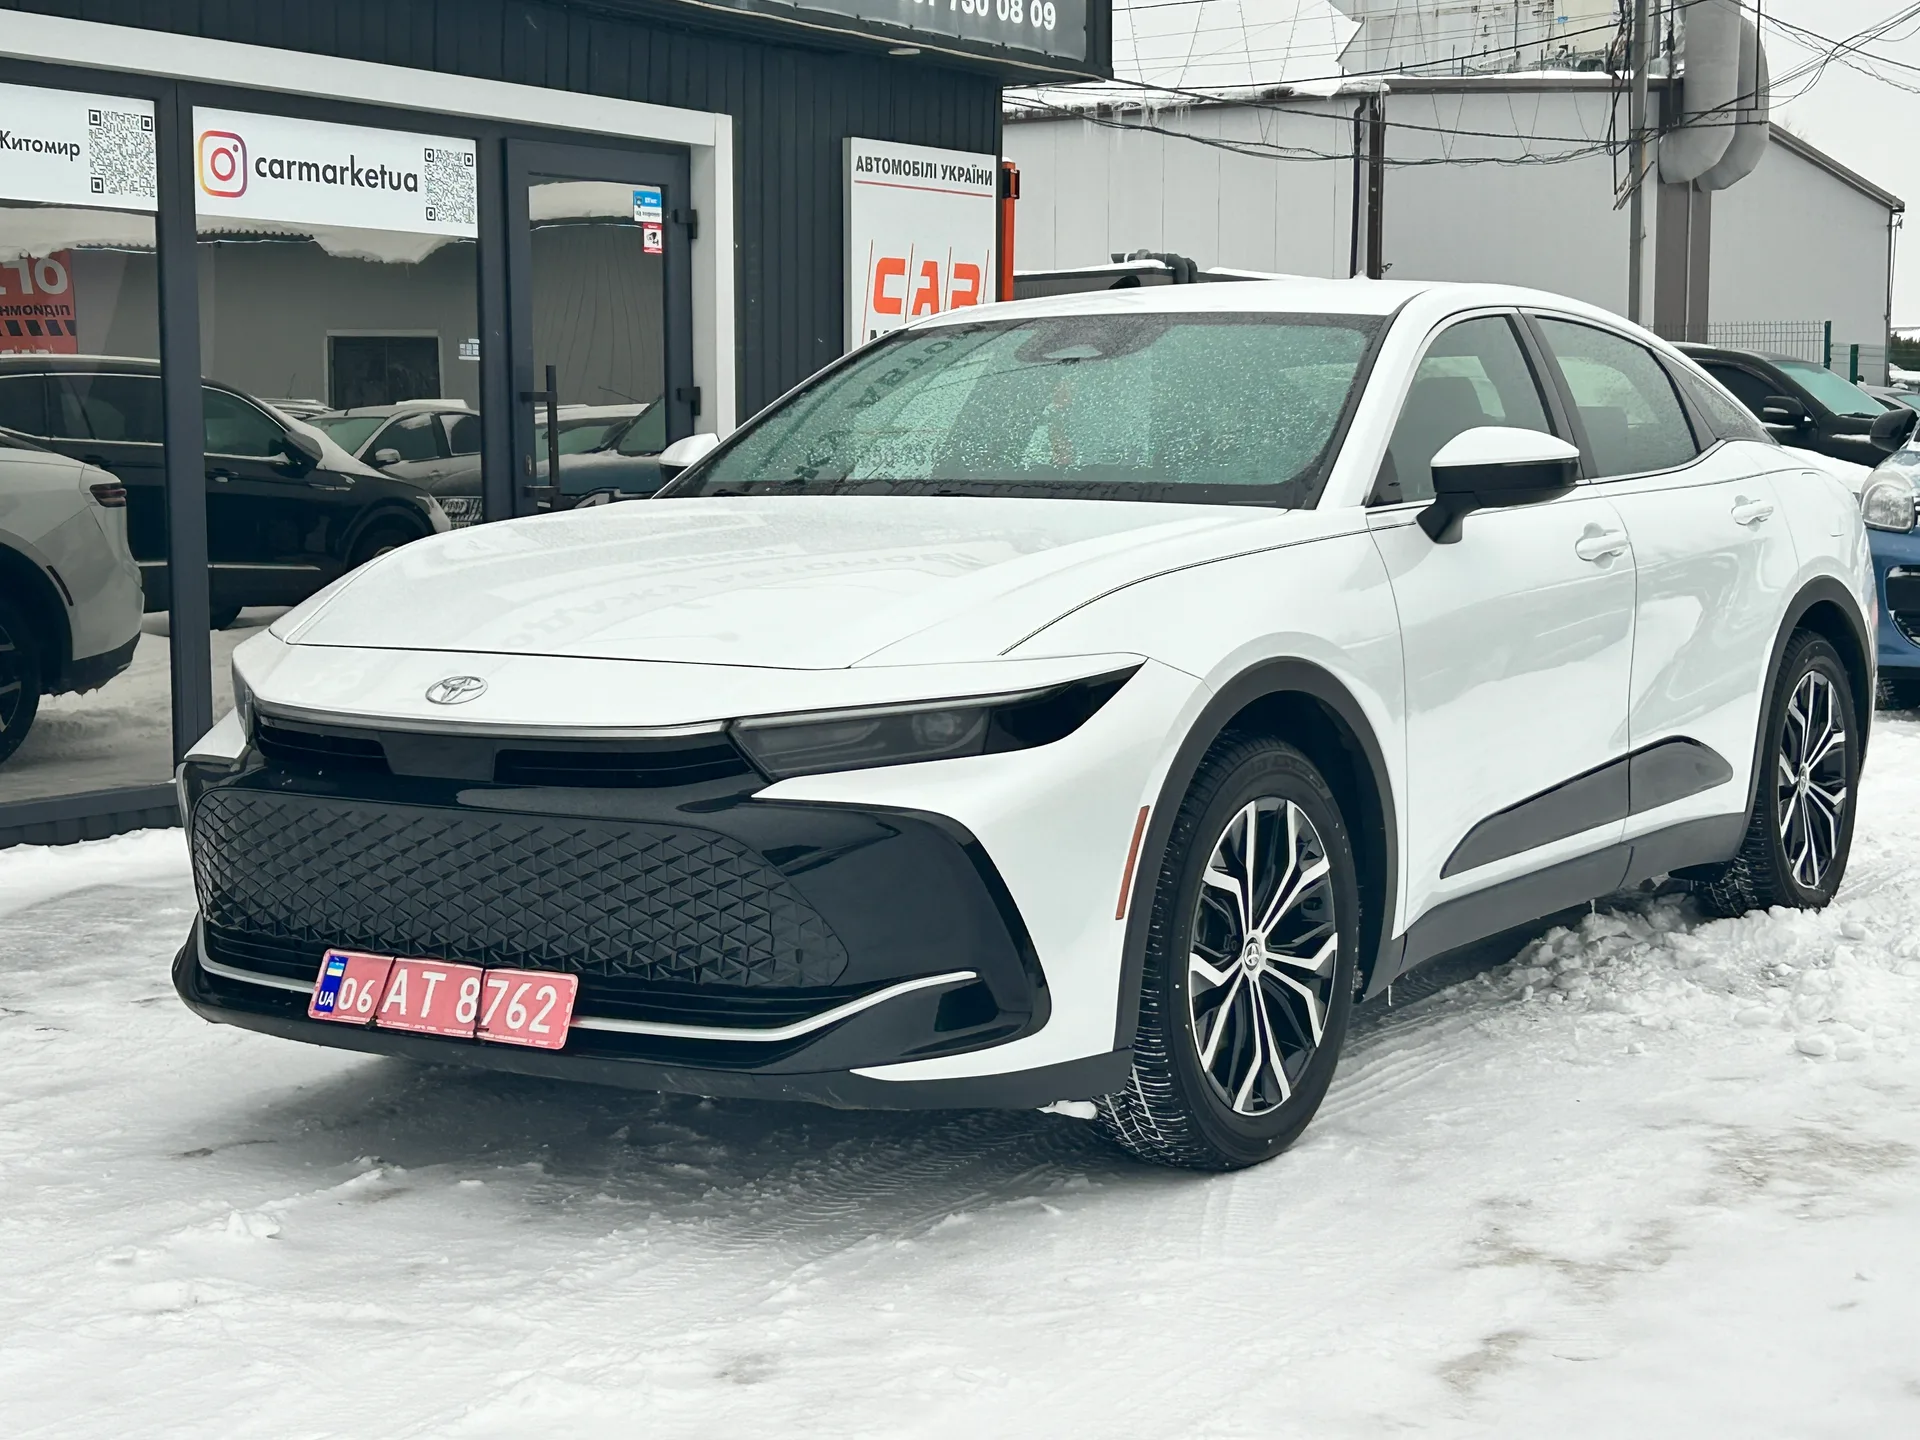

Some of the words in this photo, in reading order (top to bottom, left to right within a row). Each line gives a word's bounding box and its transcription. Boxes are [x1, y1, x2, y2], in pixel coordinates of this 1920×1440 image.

[996, 0, 1024, 23] 08
[1030, 0, 1056, 30] 09
[255, 154, 418, 192] carmarketua
[856, 155, 937, 179] АВТОМОБІЛІ
[941, 163, 993, 186] УКРАЇНИ
[873, 257, 981, 316] CAR
[318, 990, 334, 1008] UA
[338, 977, 376, 1013] 06
[381, 968, 447, 1018] AT
[456, 977, 557, 1034] 8762
